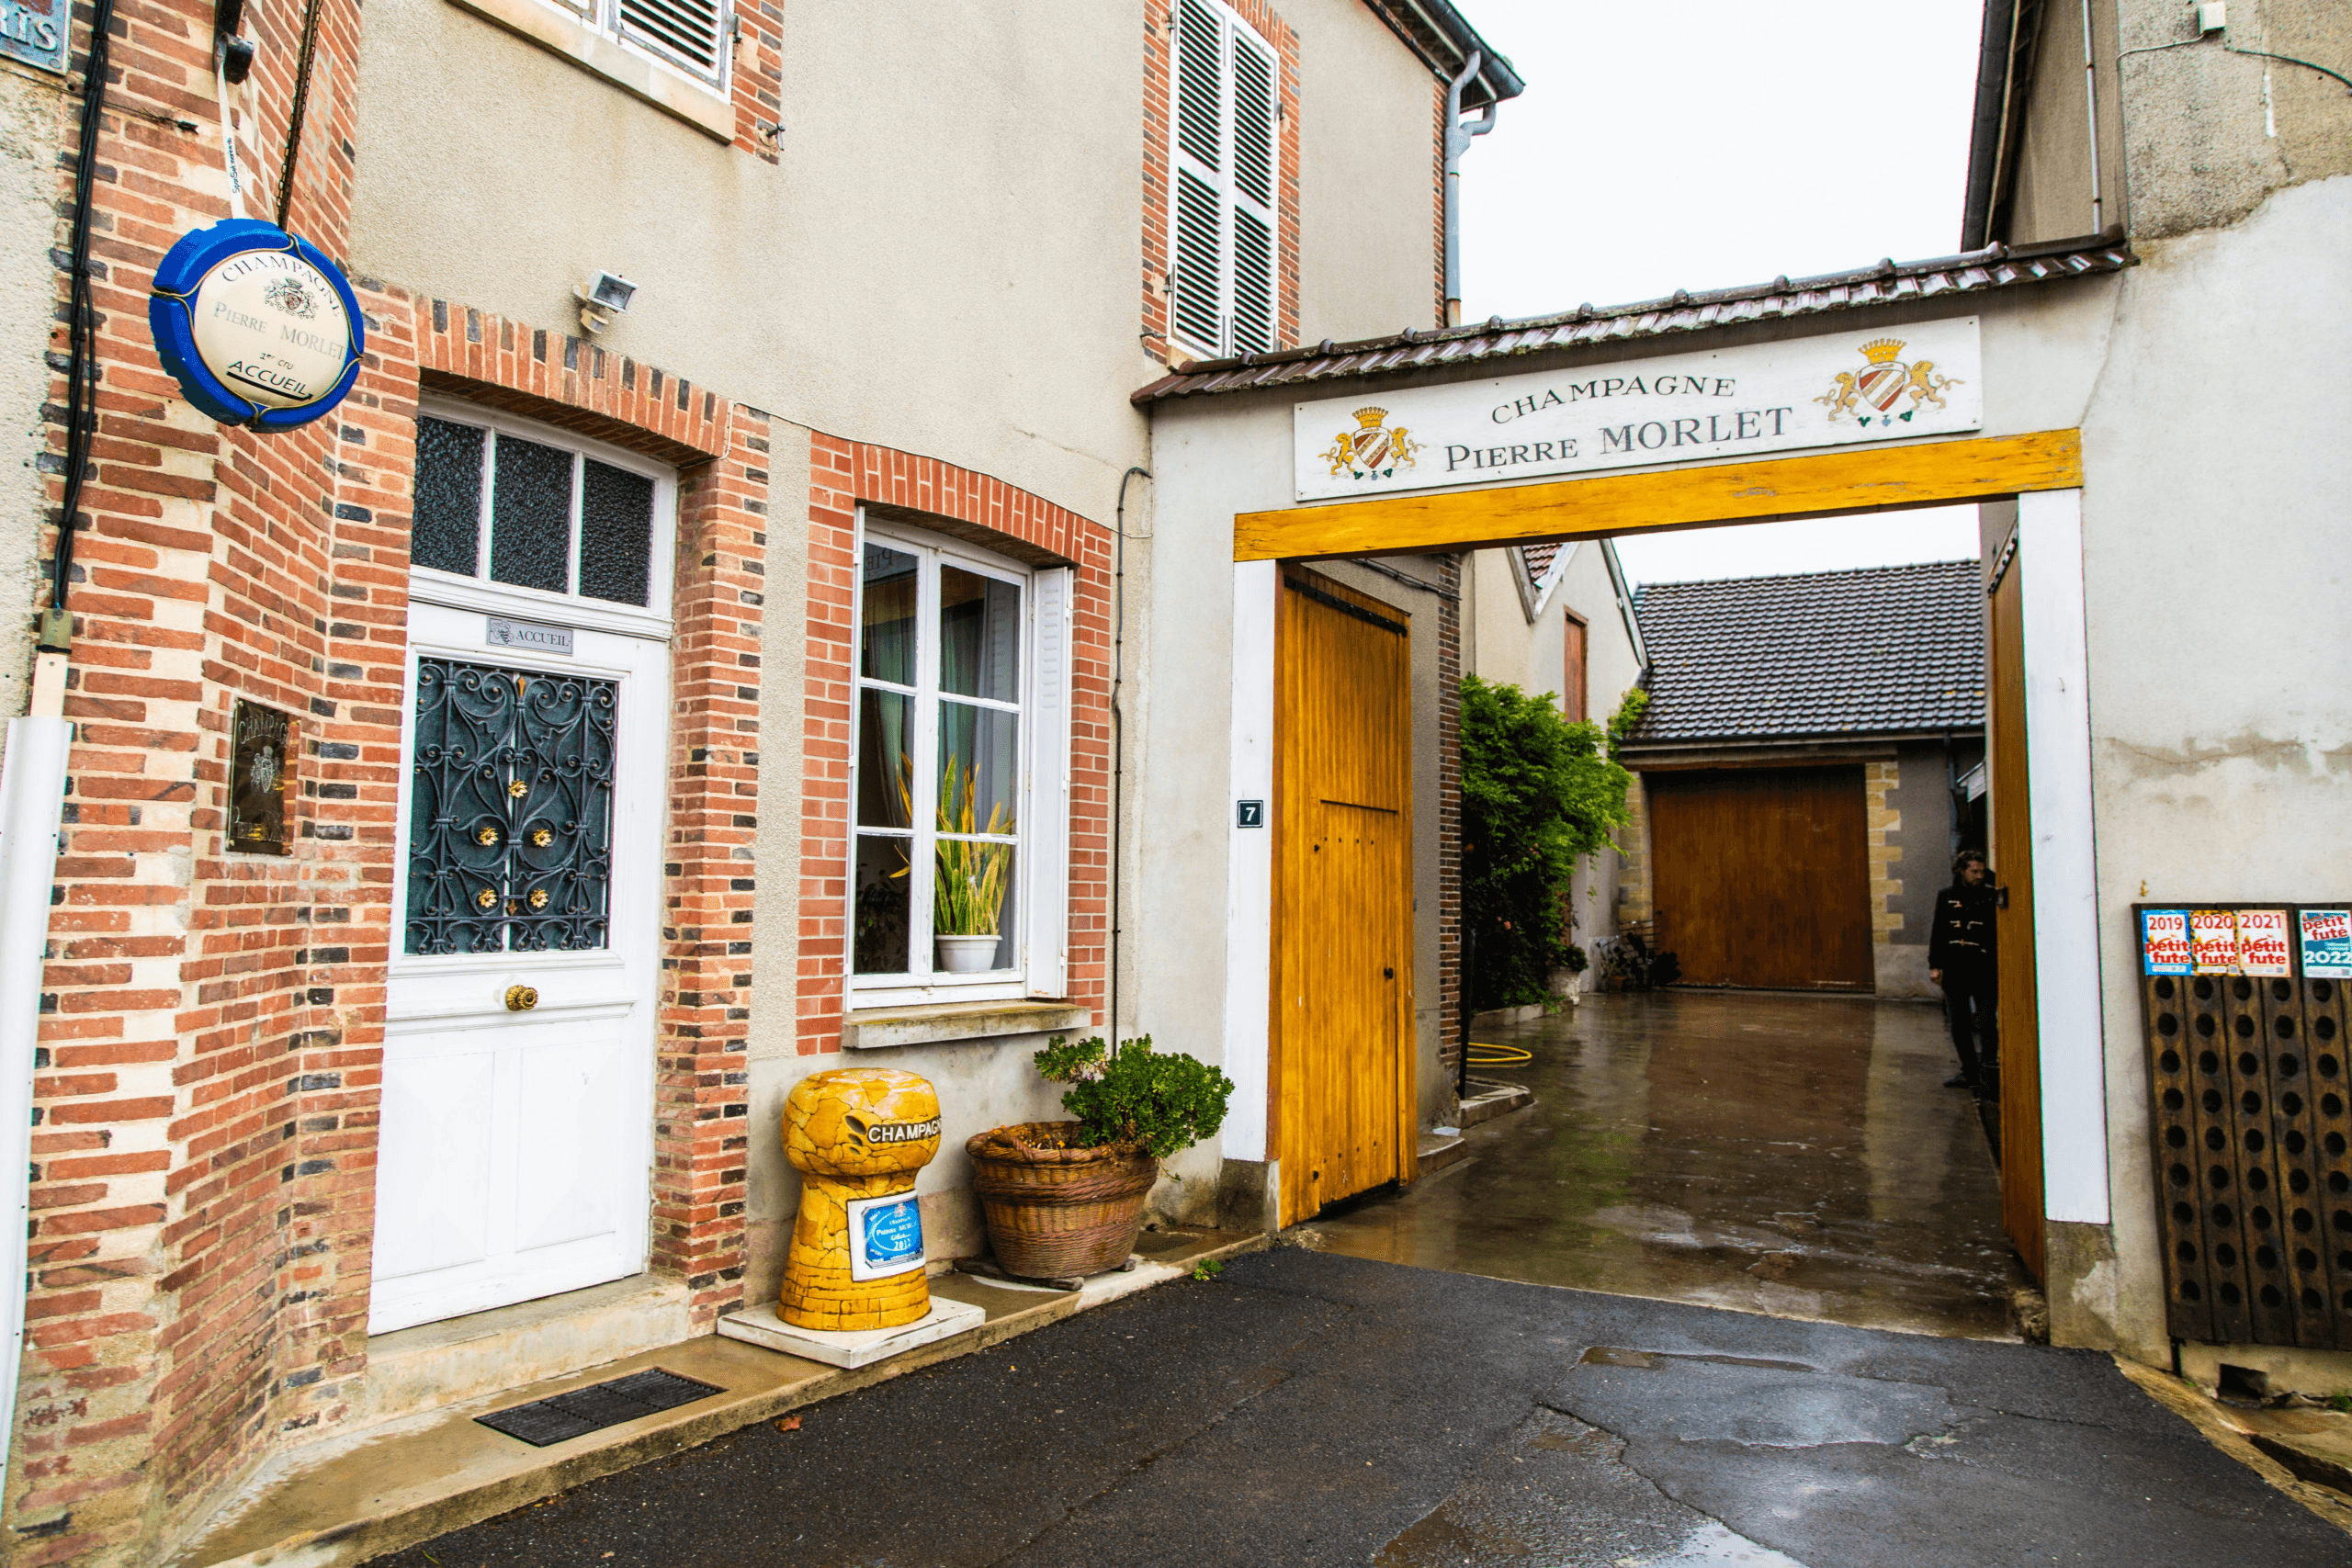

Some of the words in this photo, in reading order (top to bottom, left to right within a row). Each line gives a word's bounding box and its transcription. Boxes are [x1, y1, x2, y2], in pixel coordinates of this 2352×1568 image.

[221, 255, 342, 317] CHAMPAGNE
[213, 301, 267, 333] PIERRE
[279, 323, 345, 360] MORLET
[227, 360, 308, 396] ACCUEIL
[1491, 375, 1736, 424] CHAMPAGNE
[1443, 438, 1578, 472] PIERRE
[1598, 407, 1793, 455] MORLET
[516, 630, 570, 647] ACCUEIL
[1245, 807, 1257, 822] 7
[2148, 916, 2183, 931] 2019
[2192, 914, 2234, 930] 2020
[2241, 914, 2281, 930] 2021
[2302, 915, 2345, 933] petit
[2145, 939, 2189, 955] petit
[2192, 940, 2237, 955] petit
[2241, 940, 2286, 955] petit
[2304, 951, 2352, 964] 2022
